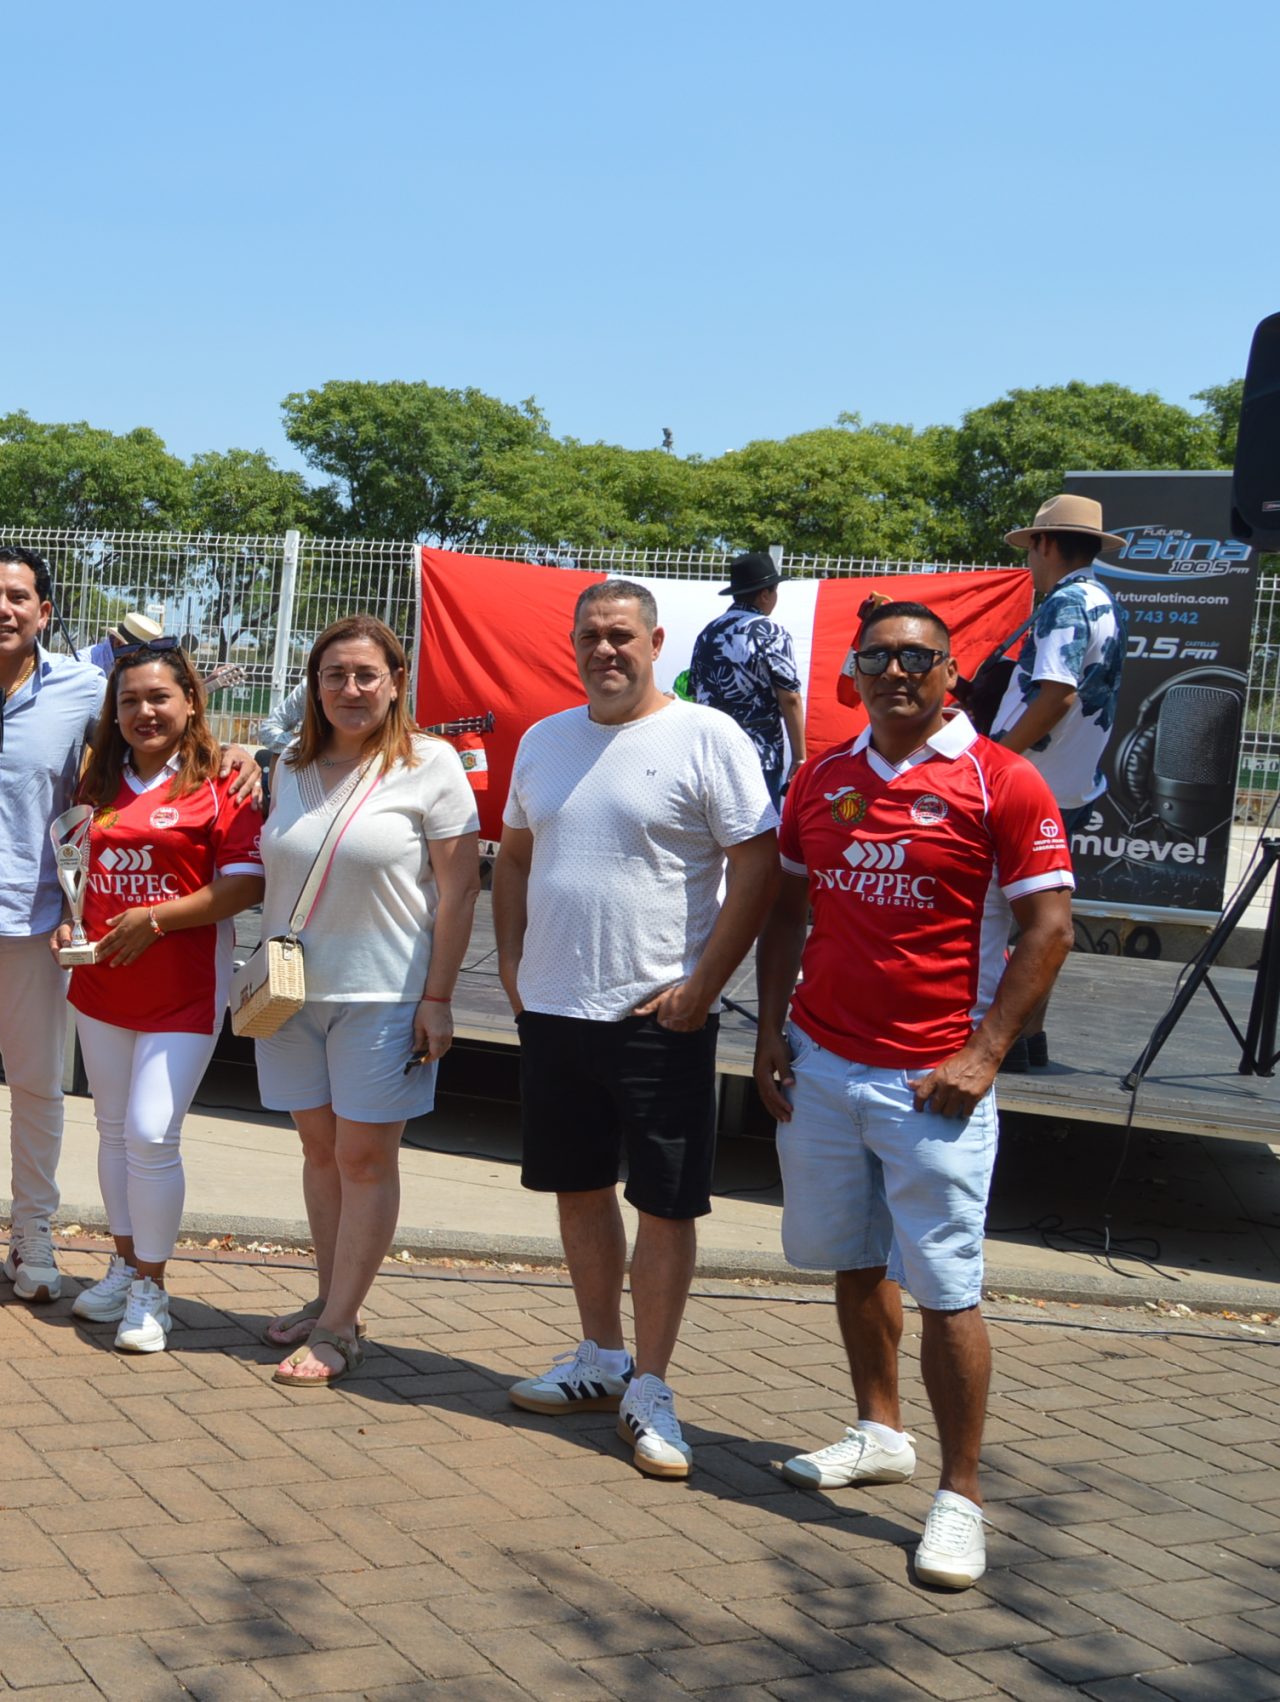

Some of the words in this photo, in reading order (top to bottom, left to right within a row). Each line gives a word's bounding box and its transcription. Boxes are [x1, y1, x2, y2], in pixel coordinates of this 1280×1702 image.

[1142, 527, 1184, 537] Futura
[1118, 532, 1252, 561] latina
[1169, 560, 1231, 575] 100.5
[1115, 592, 1229, 605] futuralatina.com
[1135, 611, 1163, 623] 743
[1169, 611, 1199, 624] 942
[1071, 834, 1207, 864] mueve!
[86, 873, 179, 894] NUPPEC
[813, 869, 936, 900] NUPPEC
[861, 894, 934, 909] logistica
